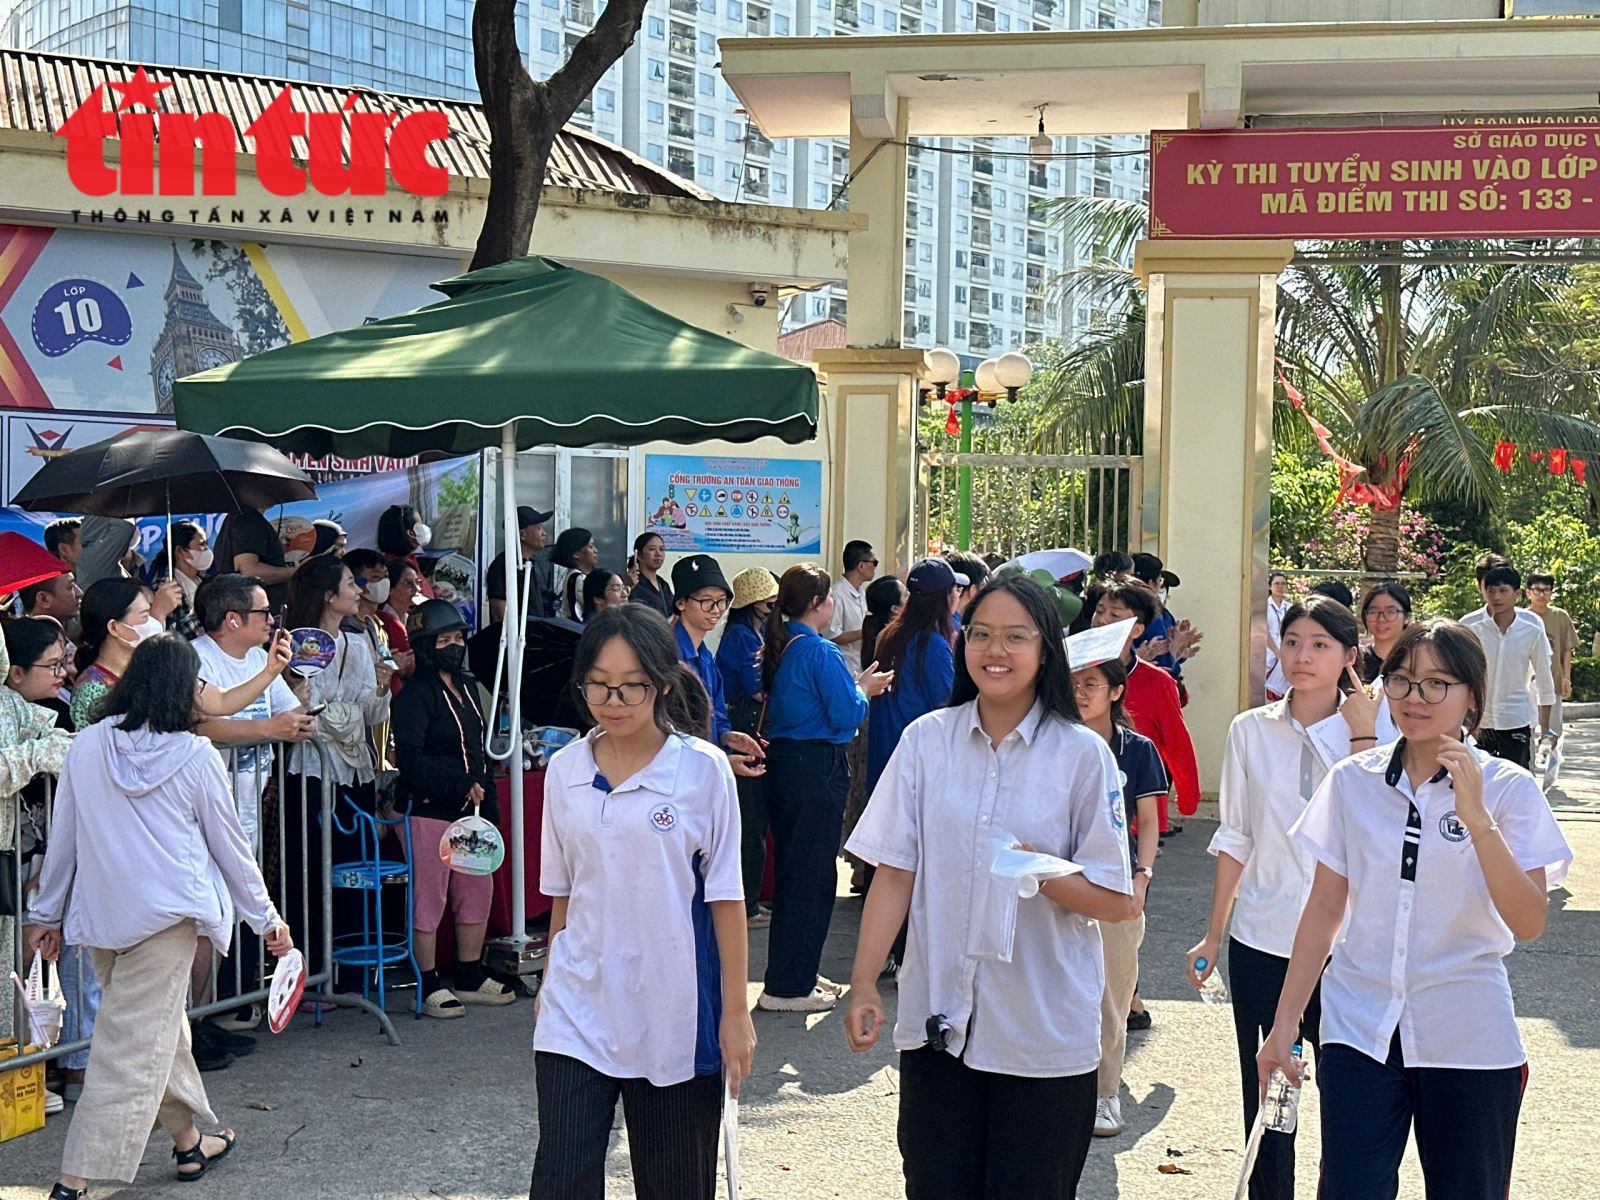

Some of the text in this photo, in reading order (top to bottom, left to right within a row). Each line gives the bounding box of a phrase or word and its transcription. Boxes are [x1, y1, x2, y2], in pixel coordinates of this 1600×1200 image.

[1453, 130, 1482, 149] SỞ
[1488, 131, 1538, 149] GIÁO
[1544, 133, 1587, 150] DỤC
[1187, 152, 1599, 185] KỲ THI TUYỂN SINH VÀO LỚP
[1260, 188, 1308, 214] MÃ
[1316, 182, 1393, 214] ĐIỂM
[1402, 189, 1448, 212] THI
[1458, 181, 1507, 211] SỐ:
[1518, 187, 1573, 211] 133
[63, 285, 87, 297] LỚP
[53, 297, 103, 336] 10
[723, 476, 735, 486] AN
[757, 477, 774, 487] GIAO
